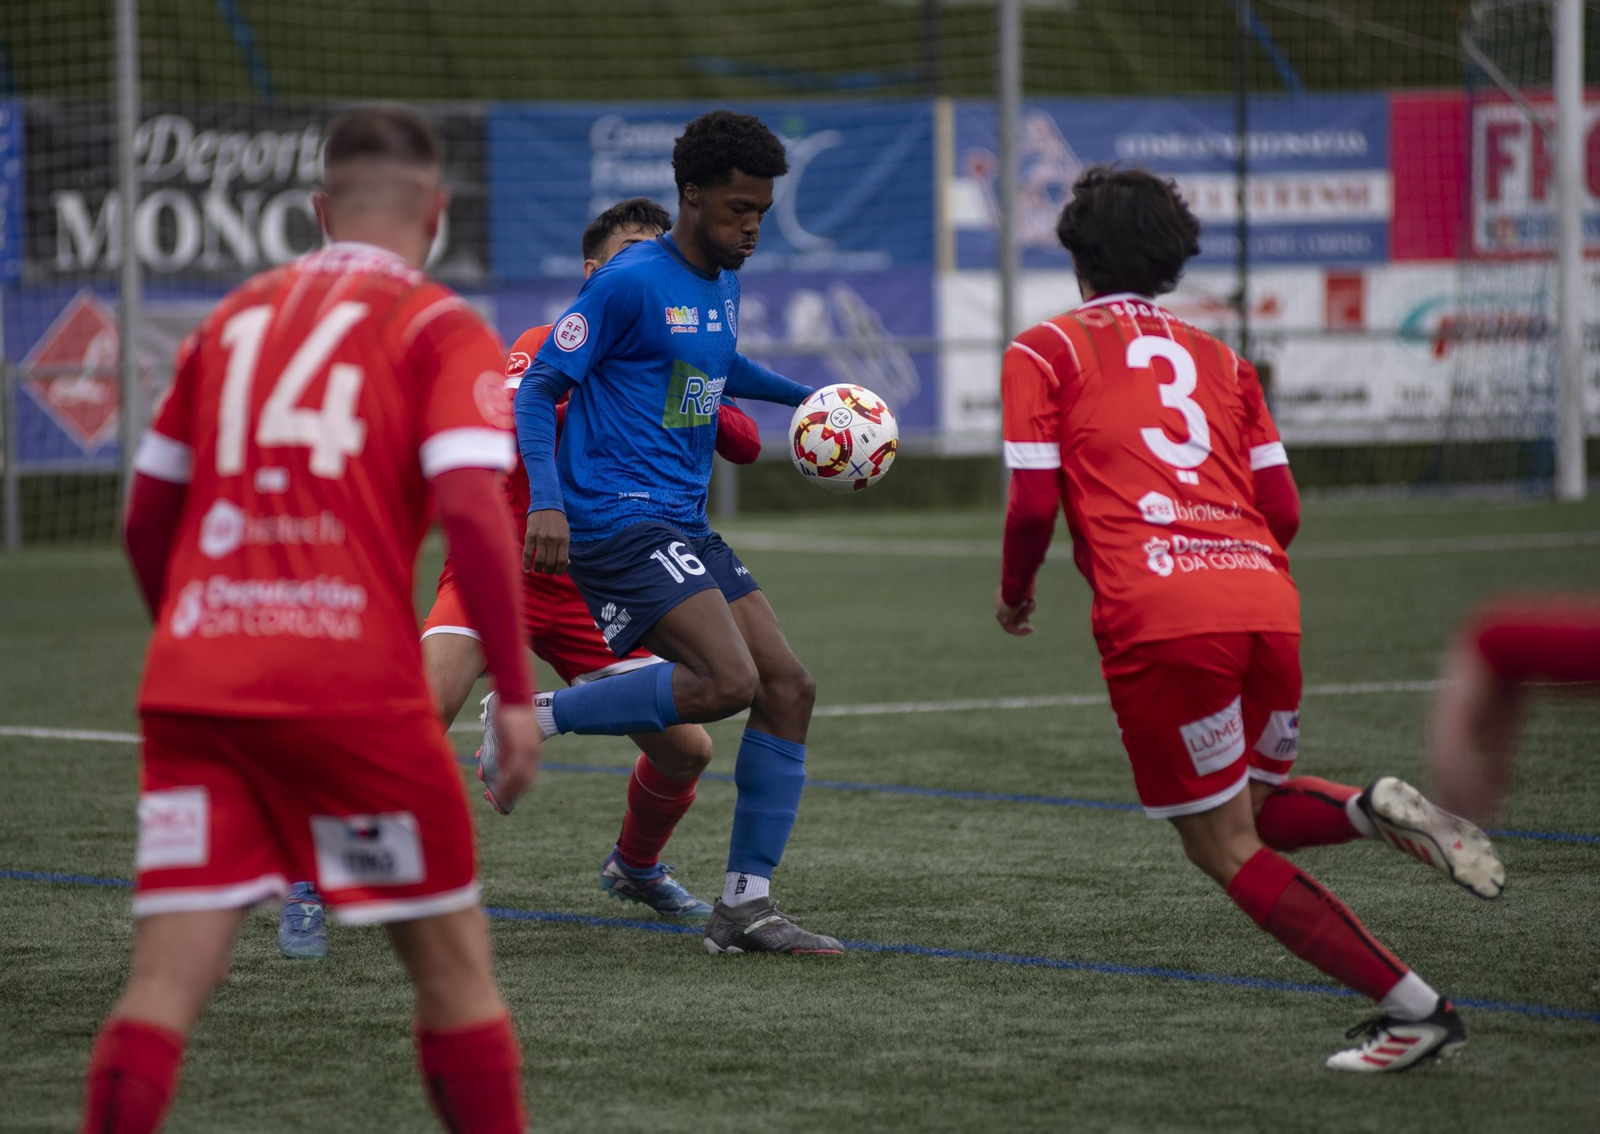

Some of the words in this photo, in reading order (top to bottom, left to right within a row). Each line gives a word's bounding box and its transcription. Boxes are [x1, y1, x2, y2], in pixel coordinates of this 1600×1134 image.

[133, 114, 326, 197] Deport
[215, 301, 370, 480] 14
[679, 376, 722, 415] Ra
[1126, 335, 1213, 469] 3
[649, 541, 706, 584] 16
[1177, 555, 1209, 572] DA
[1188, 712, 1243, 753] LUME
